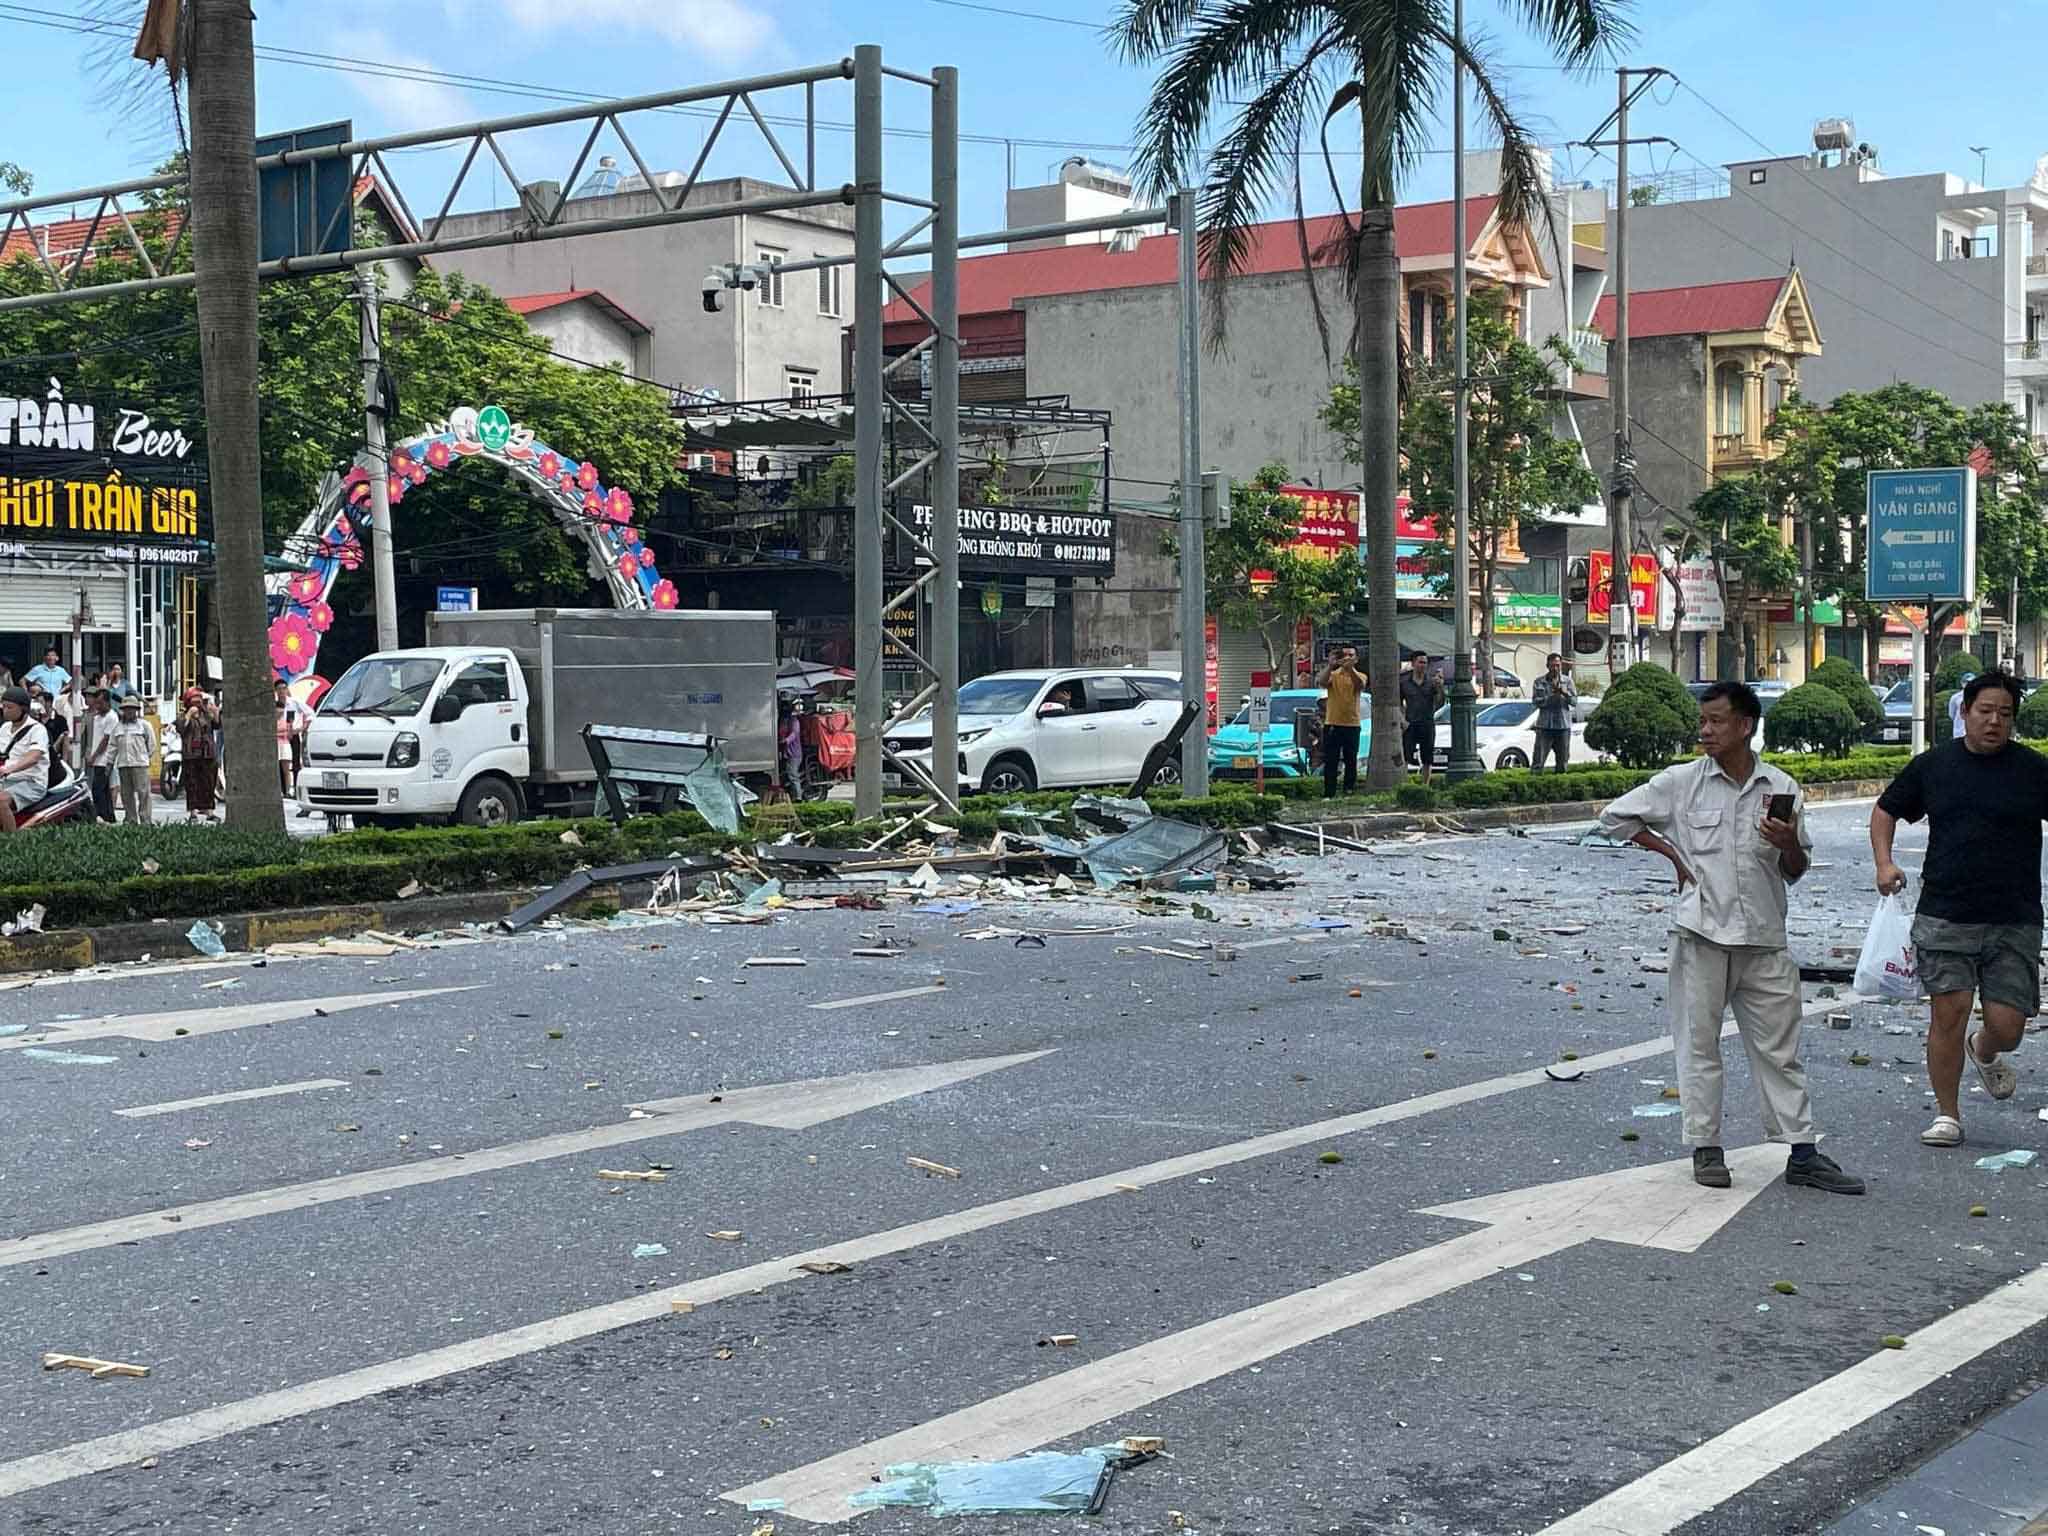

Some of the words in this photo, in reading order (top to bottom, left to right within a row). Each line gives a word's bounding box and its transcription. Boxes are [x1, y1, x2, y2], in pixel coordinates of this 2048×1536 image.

[112, 408, 193, 458] Beer
[64, 468, 142, 533] TRẦN
[152, 487, 197, 535] GIA
[1913, 501, 1957, 516] GIANG
[999, 511, 1033, 536] BBQ
[1036, 515, 1050, 534] &
[1050, 515, 1112, 538] HOTPOT
[979, 535, 1016, 558] KHÔNG
